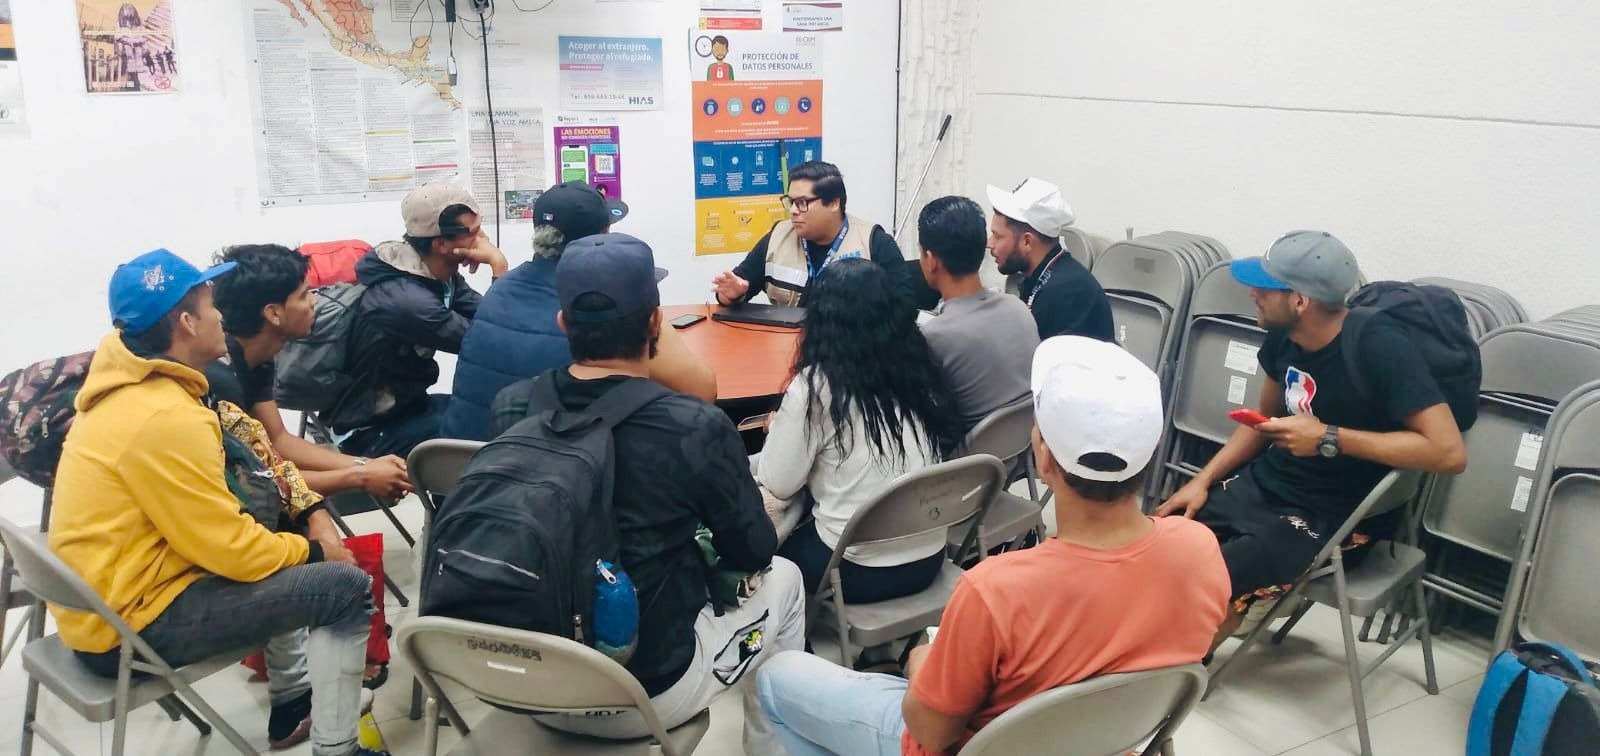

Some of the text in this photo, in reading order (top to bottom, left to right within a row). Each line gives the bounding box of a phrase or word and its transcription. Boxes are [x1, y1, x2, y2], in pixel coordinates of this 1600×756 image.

[569, 42, 649, 52] Acoger al extranjero.
[569, 52, 604, 62] Proteger
[742, 52, 789, 61] PROTECCIÓN
[742, 62, 813, 71] DATOS PERSONALES
[629, 96, 654, 105] HIAS
[561, 127, 611, 136] LAS EMOCIONES
